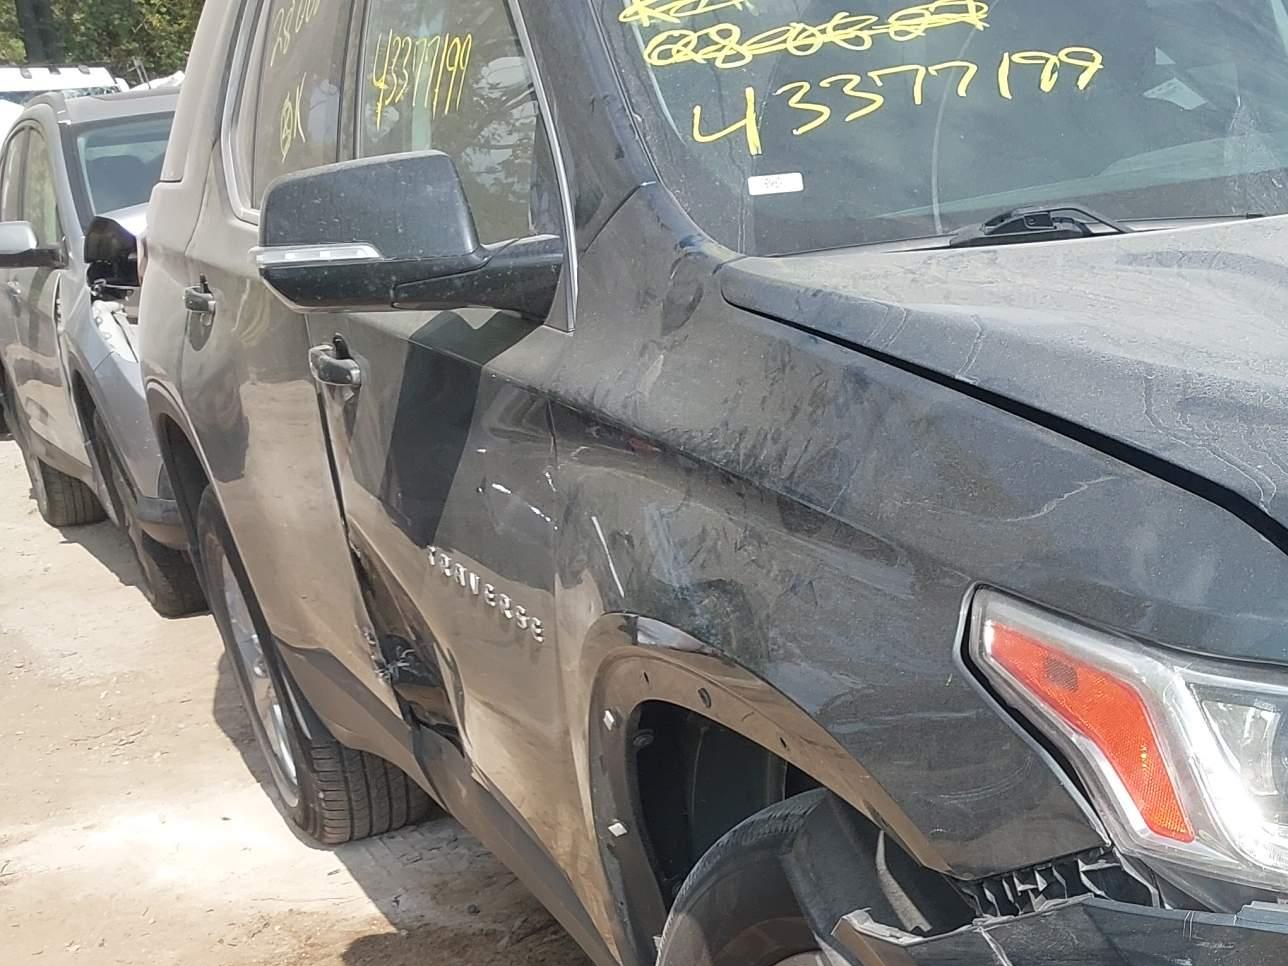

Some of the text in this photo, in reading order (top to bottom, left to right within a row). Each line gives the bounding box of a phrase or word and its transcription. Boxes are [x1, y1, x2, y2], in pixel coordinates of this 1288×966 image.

[372, 28, 472, 130] 43377199
[692, 46, 1103, 155] 43377199
[427, 545, 545, 643] TRAVERSE
